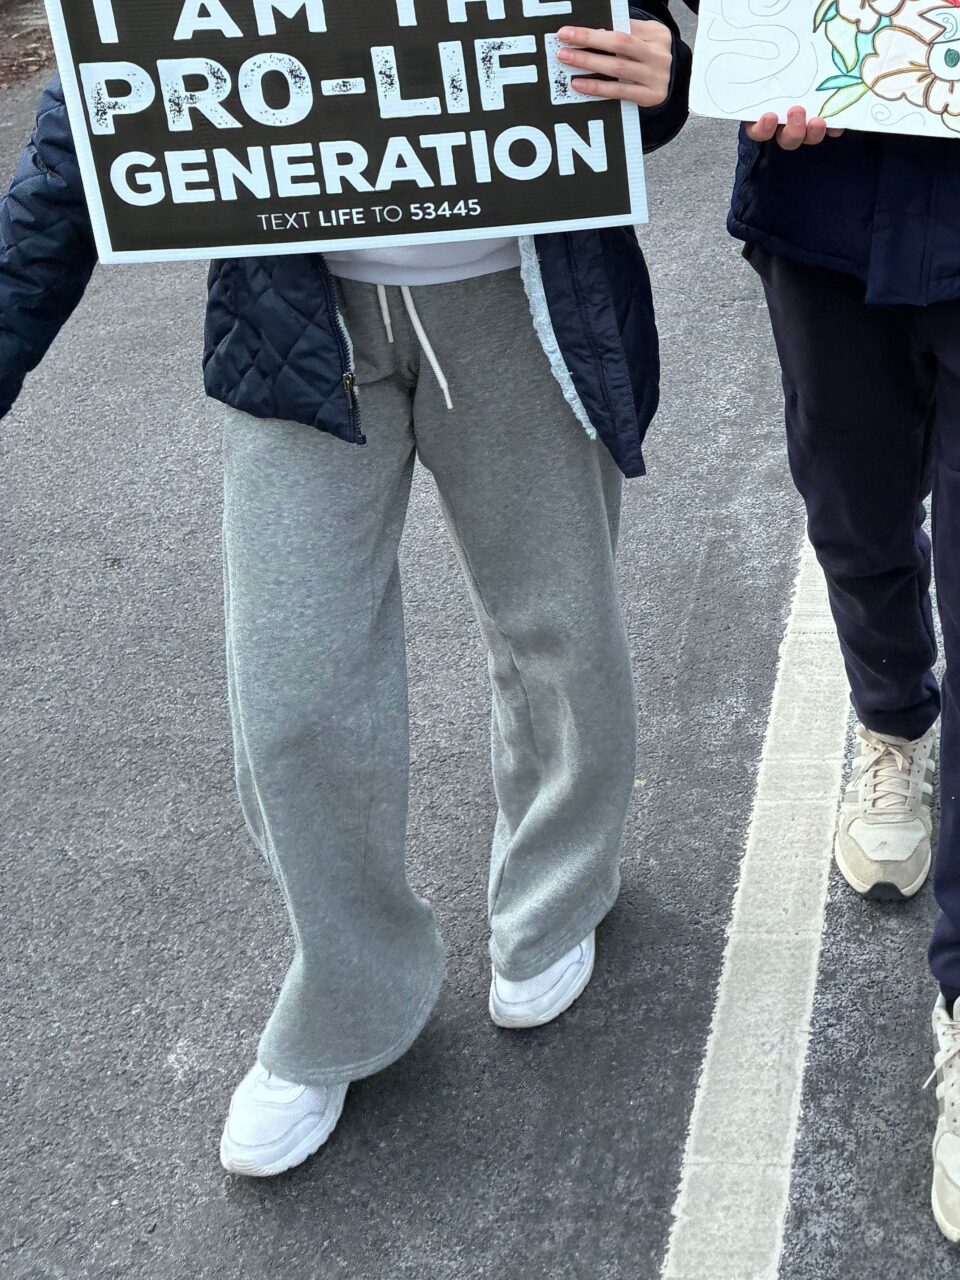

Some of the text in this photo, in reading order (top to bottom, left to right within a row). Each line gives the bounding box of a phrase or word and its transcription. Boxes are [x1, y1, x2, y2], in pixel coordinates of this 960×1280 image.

[109, 118, 609, 207] GENERATION
[257, 198, 481, 231] TEXT LIFE TO 53445
